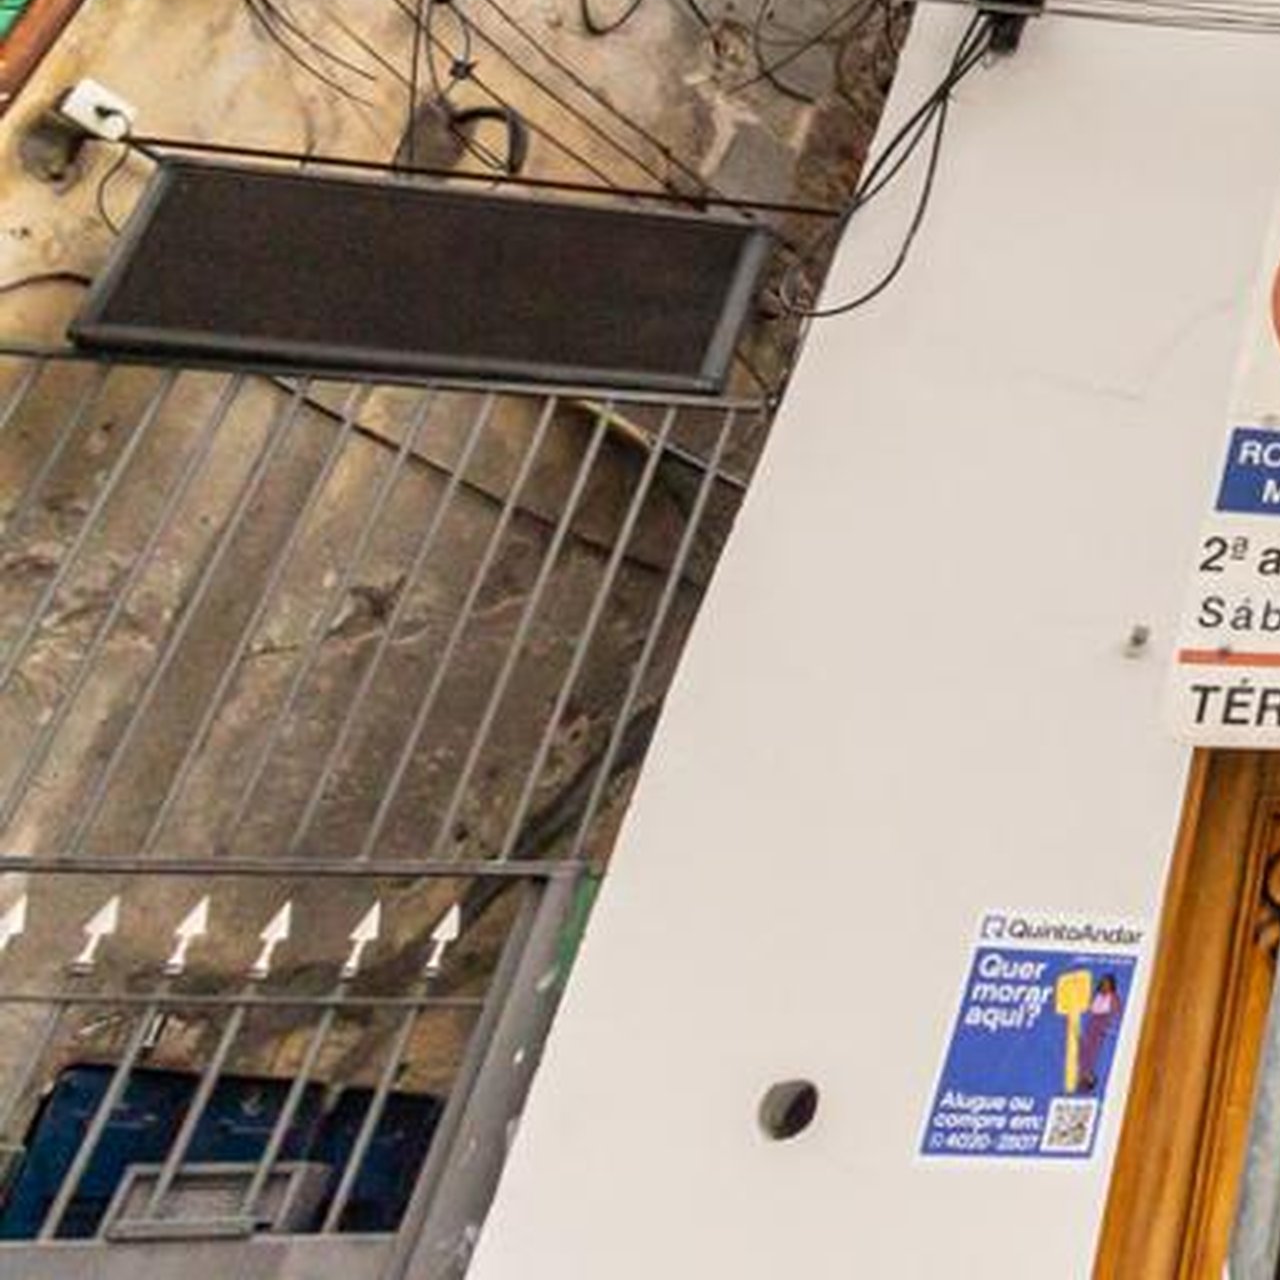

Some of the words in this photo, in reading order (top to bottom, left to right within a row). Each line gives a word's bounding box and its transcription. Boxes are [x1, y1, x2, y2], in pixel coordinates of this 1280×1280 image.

[1008, 918, 1144, 945] QuintoAndar
[977, 952, 1048, 980] Quer
[970, 982, 1054, 1005] morar
[964, 1002, 1043, 1032] aqui?
